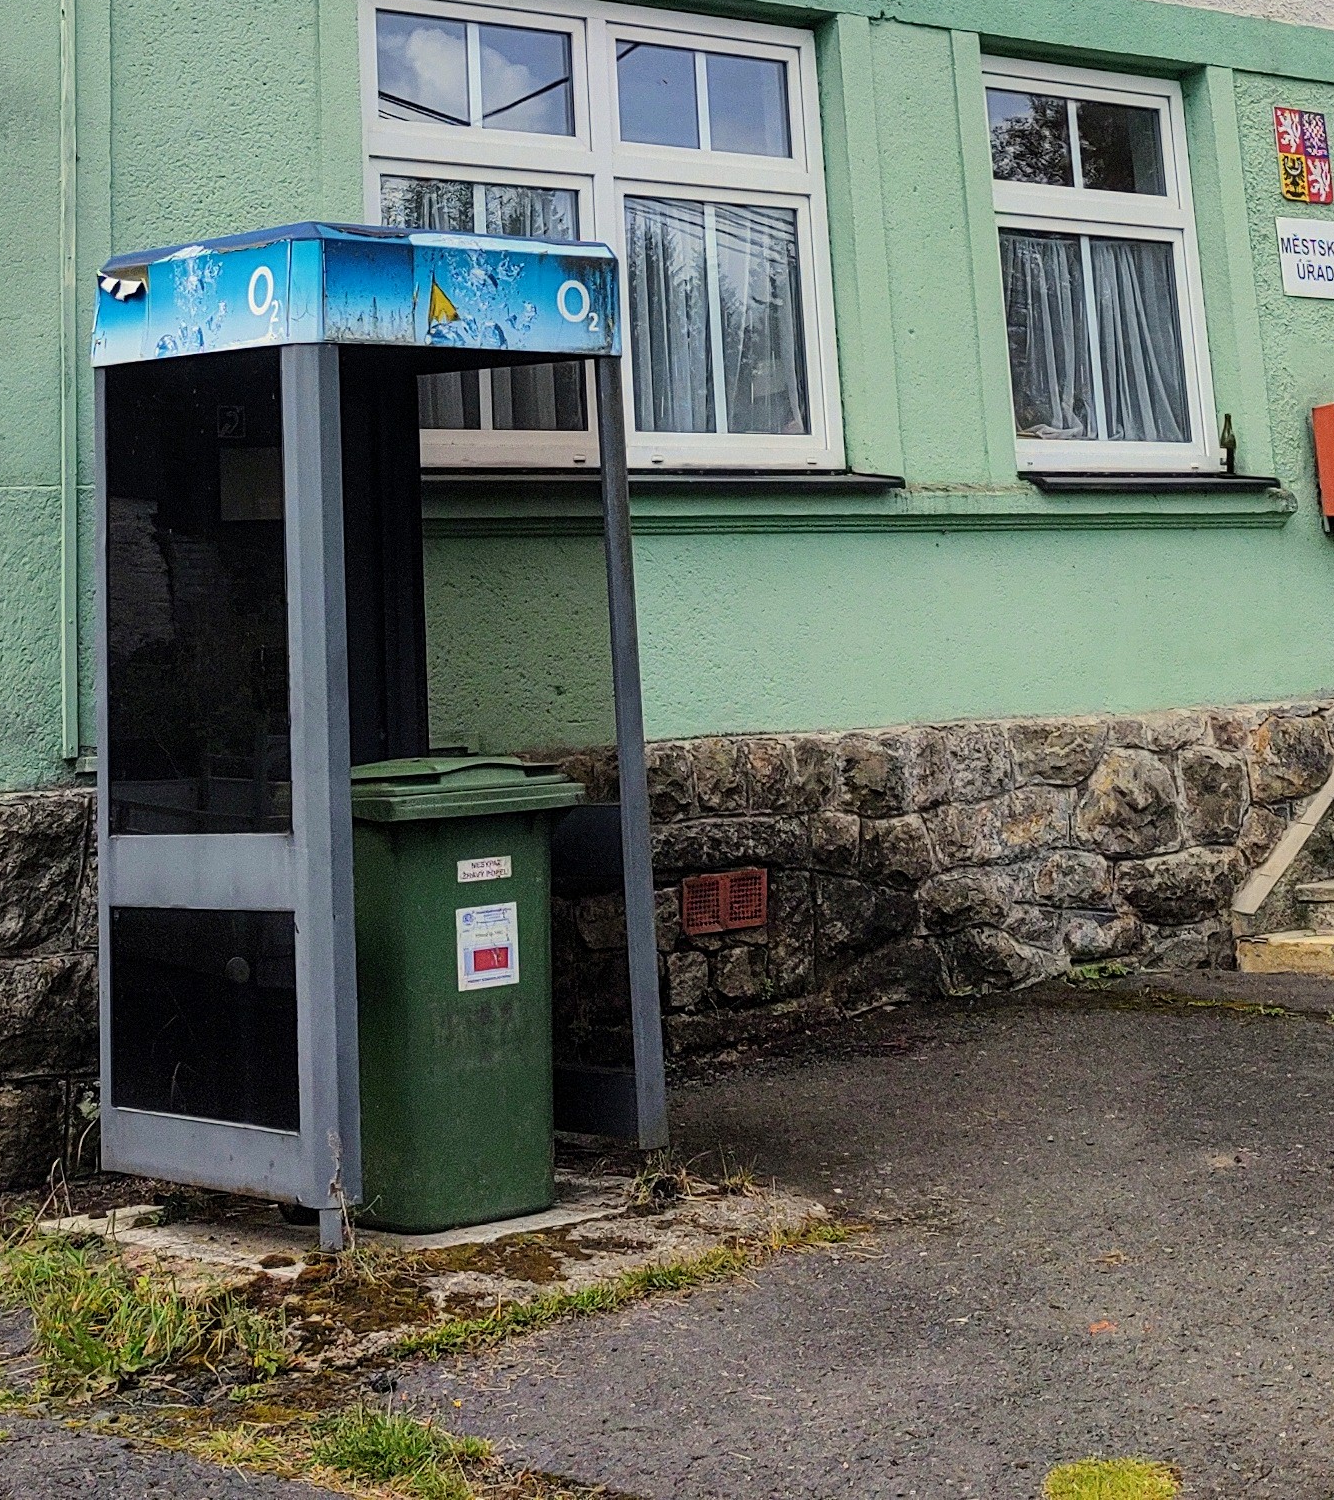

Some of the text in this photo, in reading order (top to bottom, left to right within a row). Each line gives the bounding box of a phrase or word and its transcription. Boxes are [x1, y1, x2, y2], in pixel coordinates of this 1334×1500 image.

[248, 265, 279, 323] O2
[1296, 258, 1334, 281] ÚŘAD
[556, 279, 599, 331] O2
